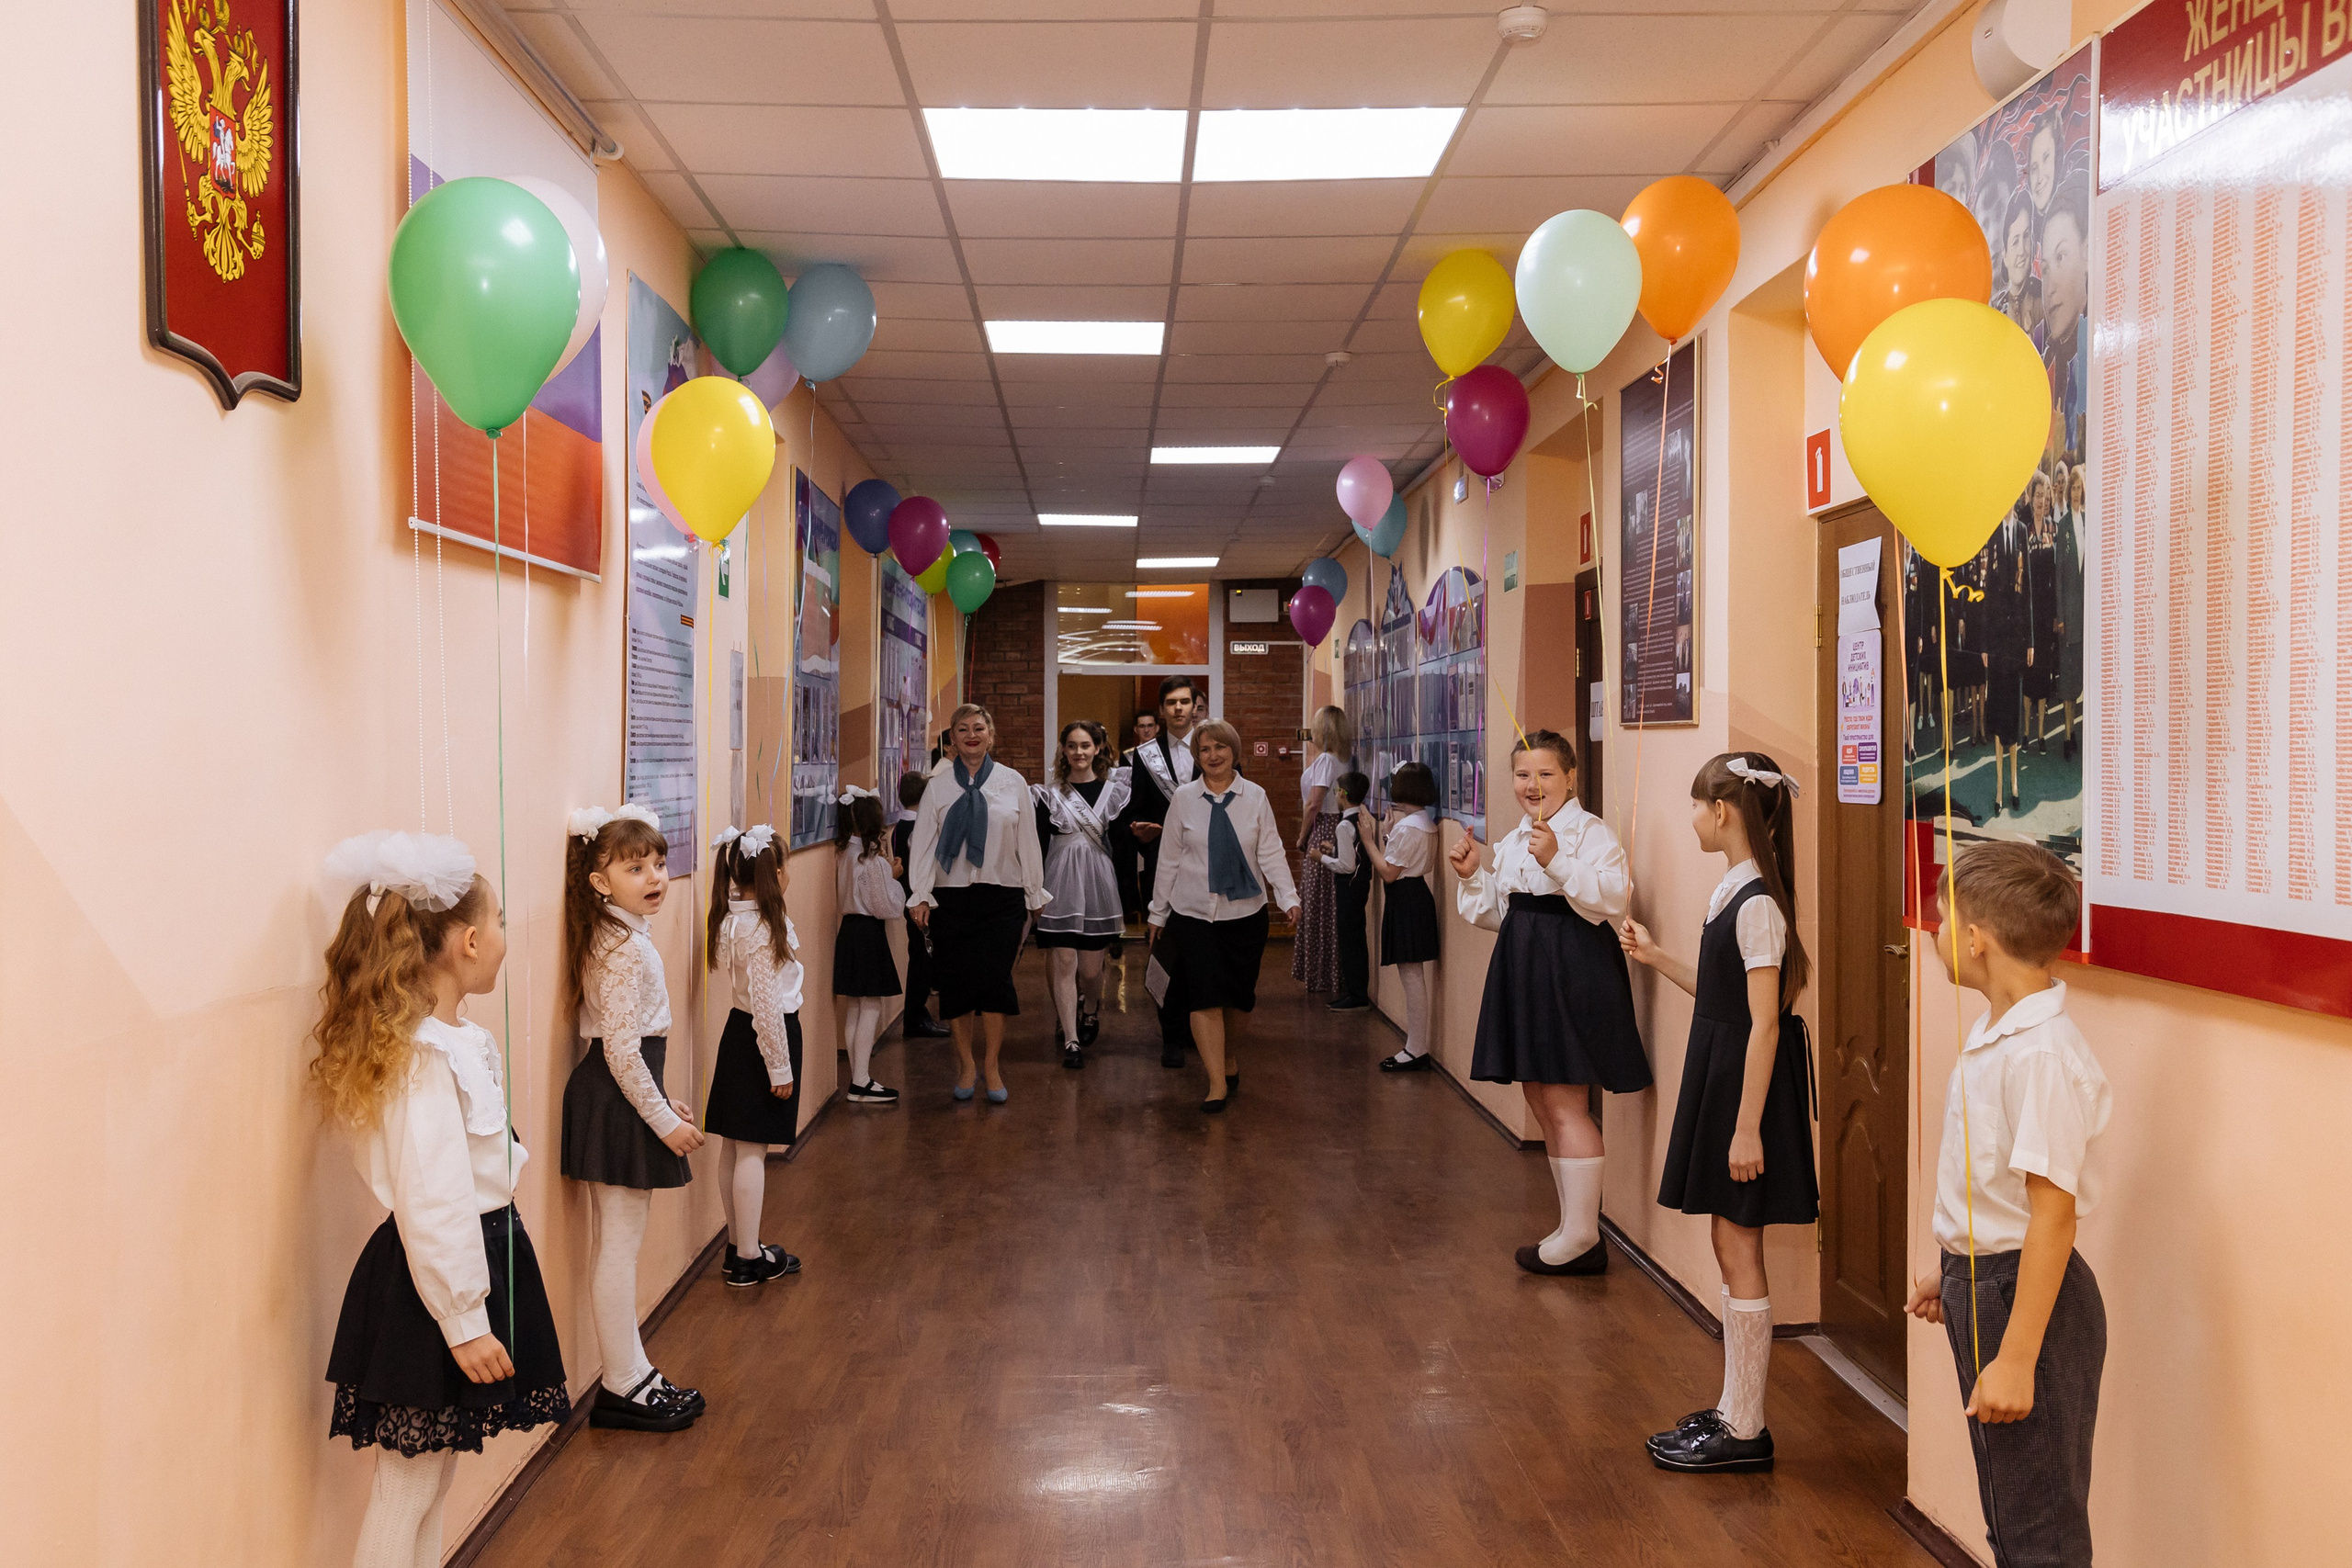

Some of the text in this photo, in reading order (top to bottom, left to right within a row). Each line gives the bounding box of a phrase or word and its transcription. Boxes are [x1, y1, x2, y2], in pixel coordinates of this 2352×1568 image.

[2122, 0, 2352, 174] УЧАСТНИЦЫ В
[1234, 644, 1265, 652] ВЫХОД
